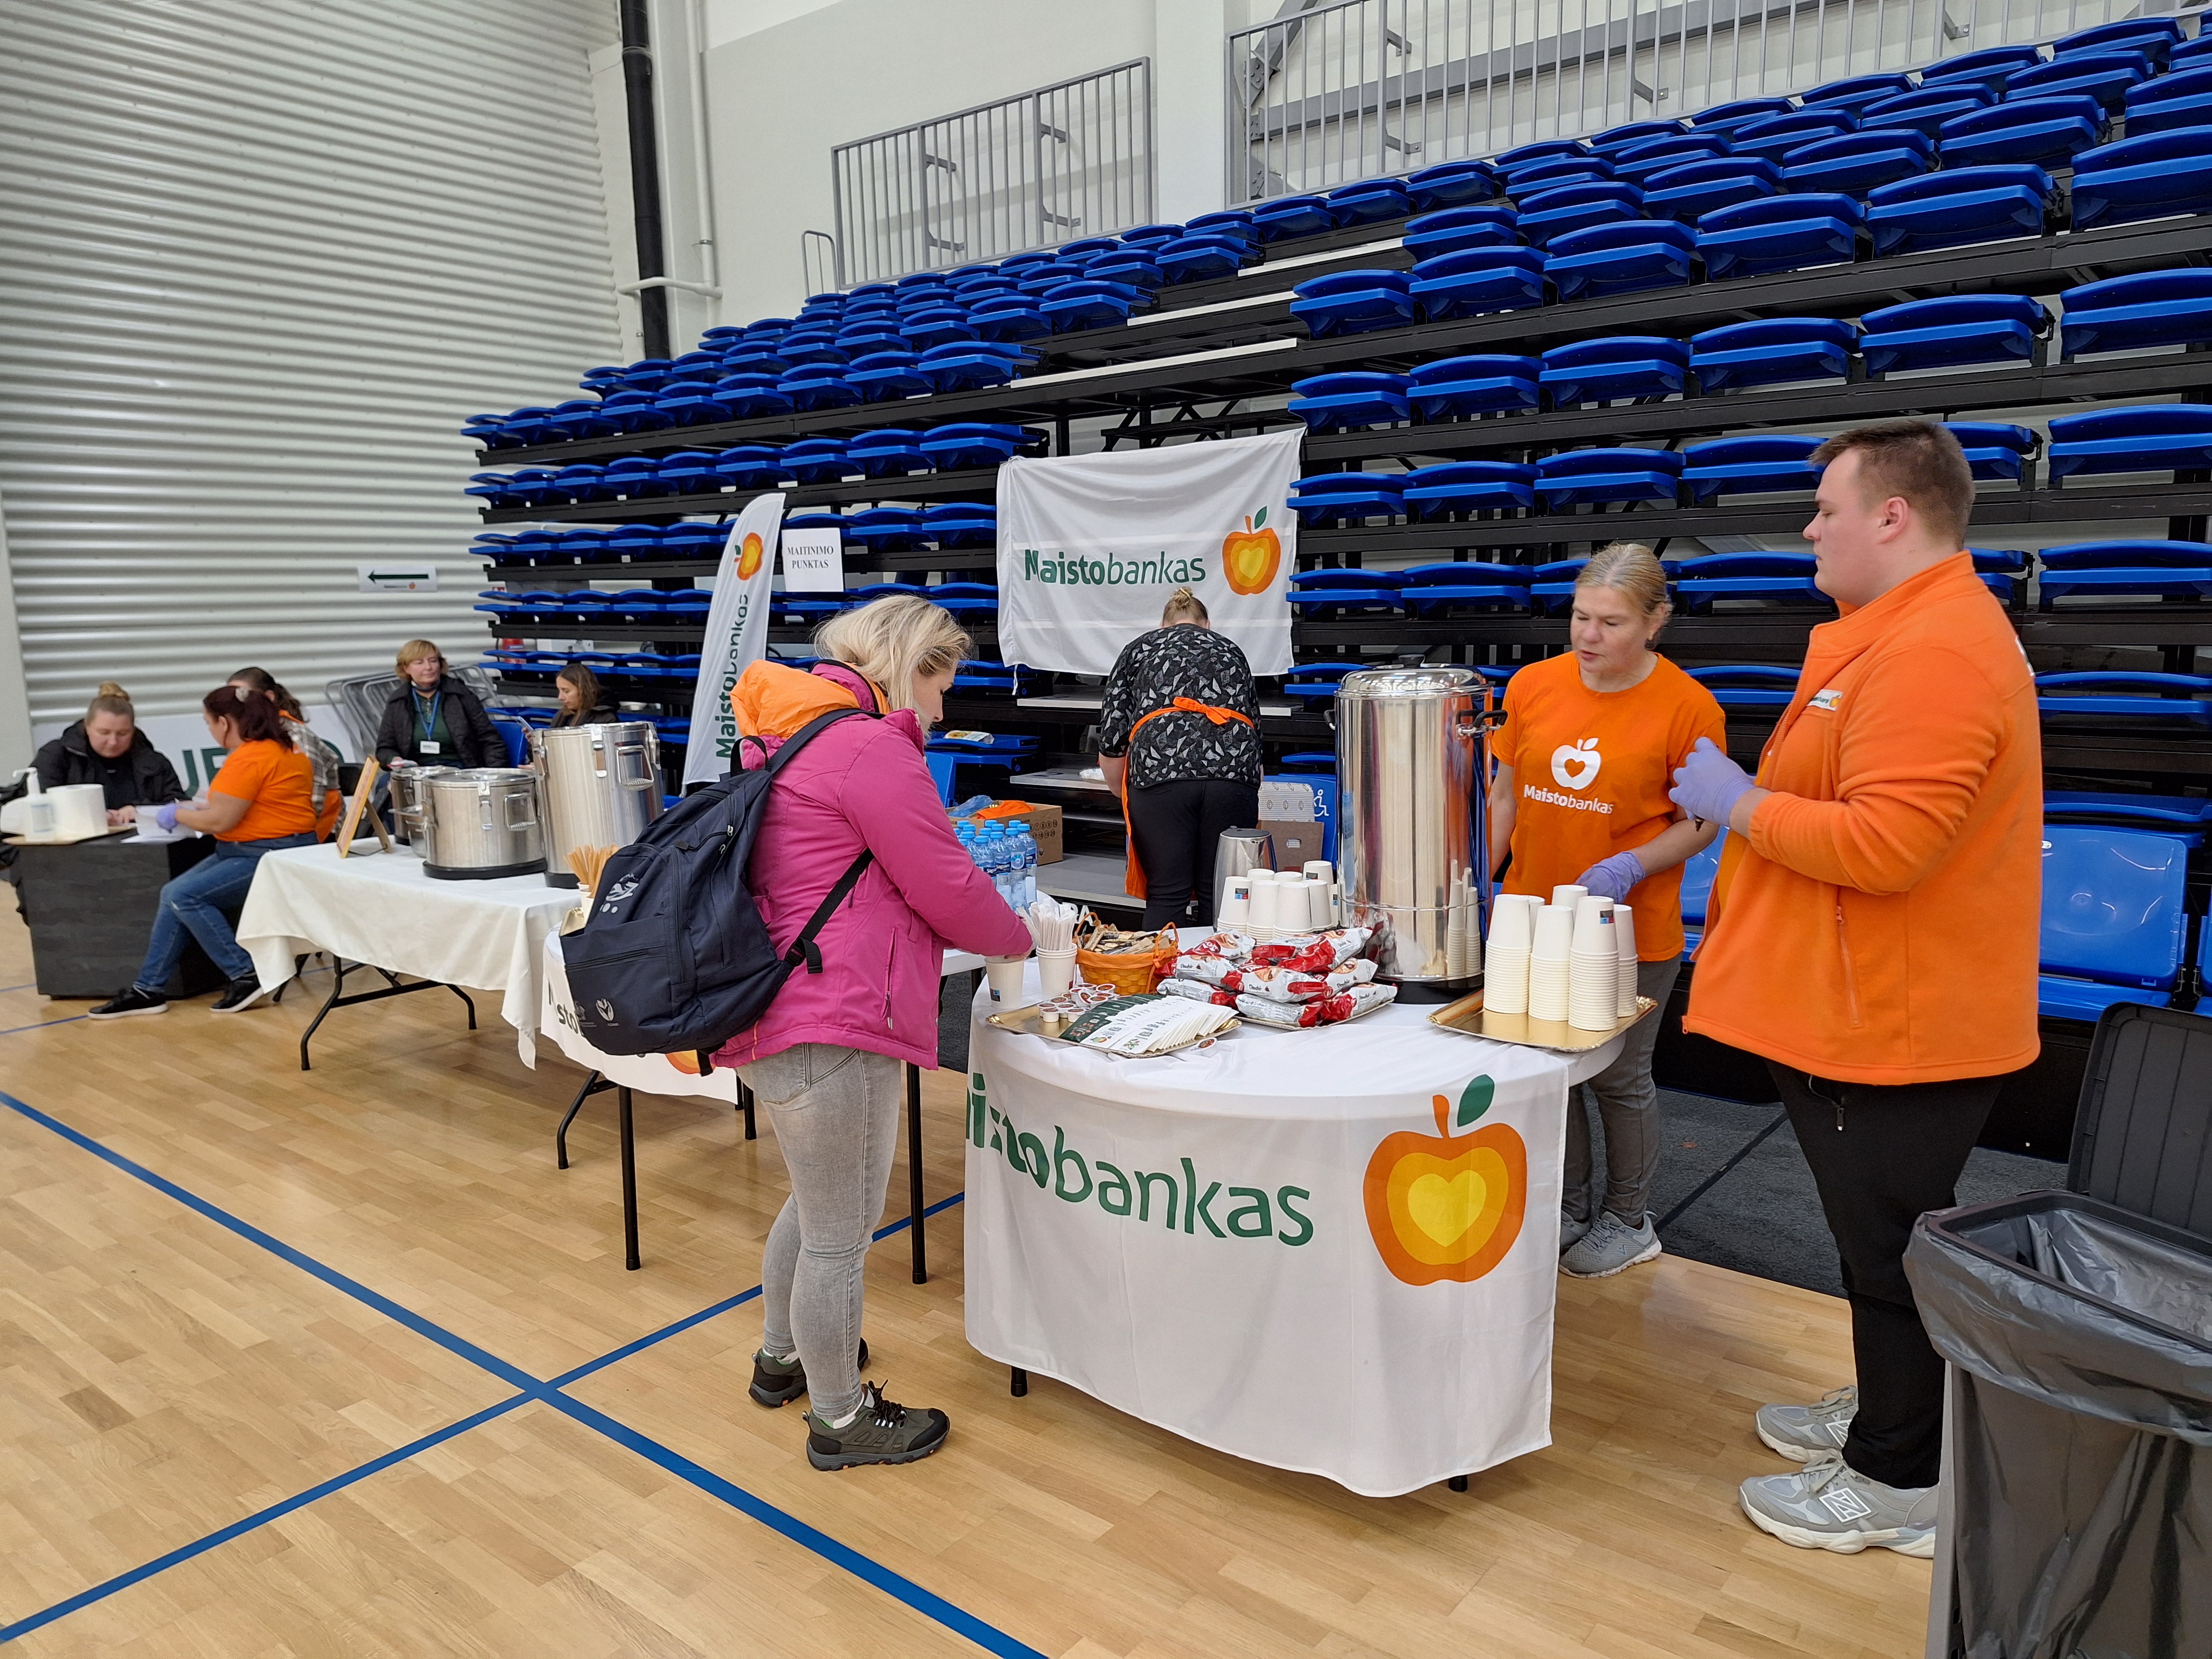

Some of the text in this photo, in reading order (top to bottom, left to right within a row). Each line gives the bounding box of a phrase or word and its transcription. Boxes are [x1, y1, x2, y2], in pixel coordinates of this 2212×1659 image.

[787, 545, 834, 555] MAITINIMO
[792, 560, 828, 569] PUNKTAS
[1024, 549, 1206, 586] Maistobankas
[1523, 784, 1614, 814] Maistobankas
